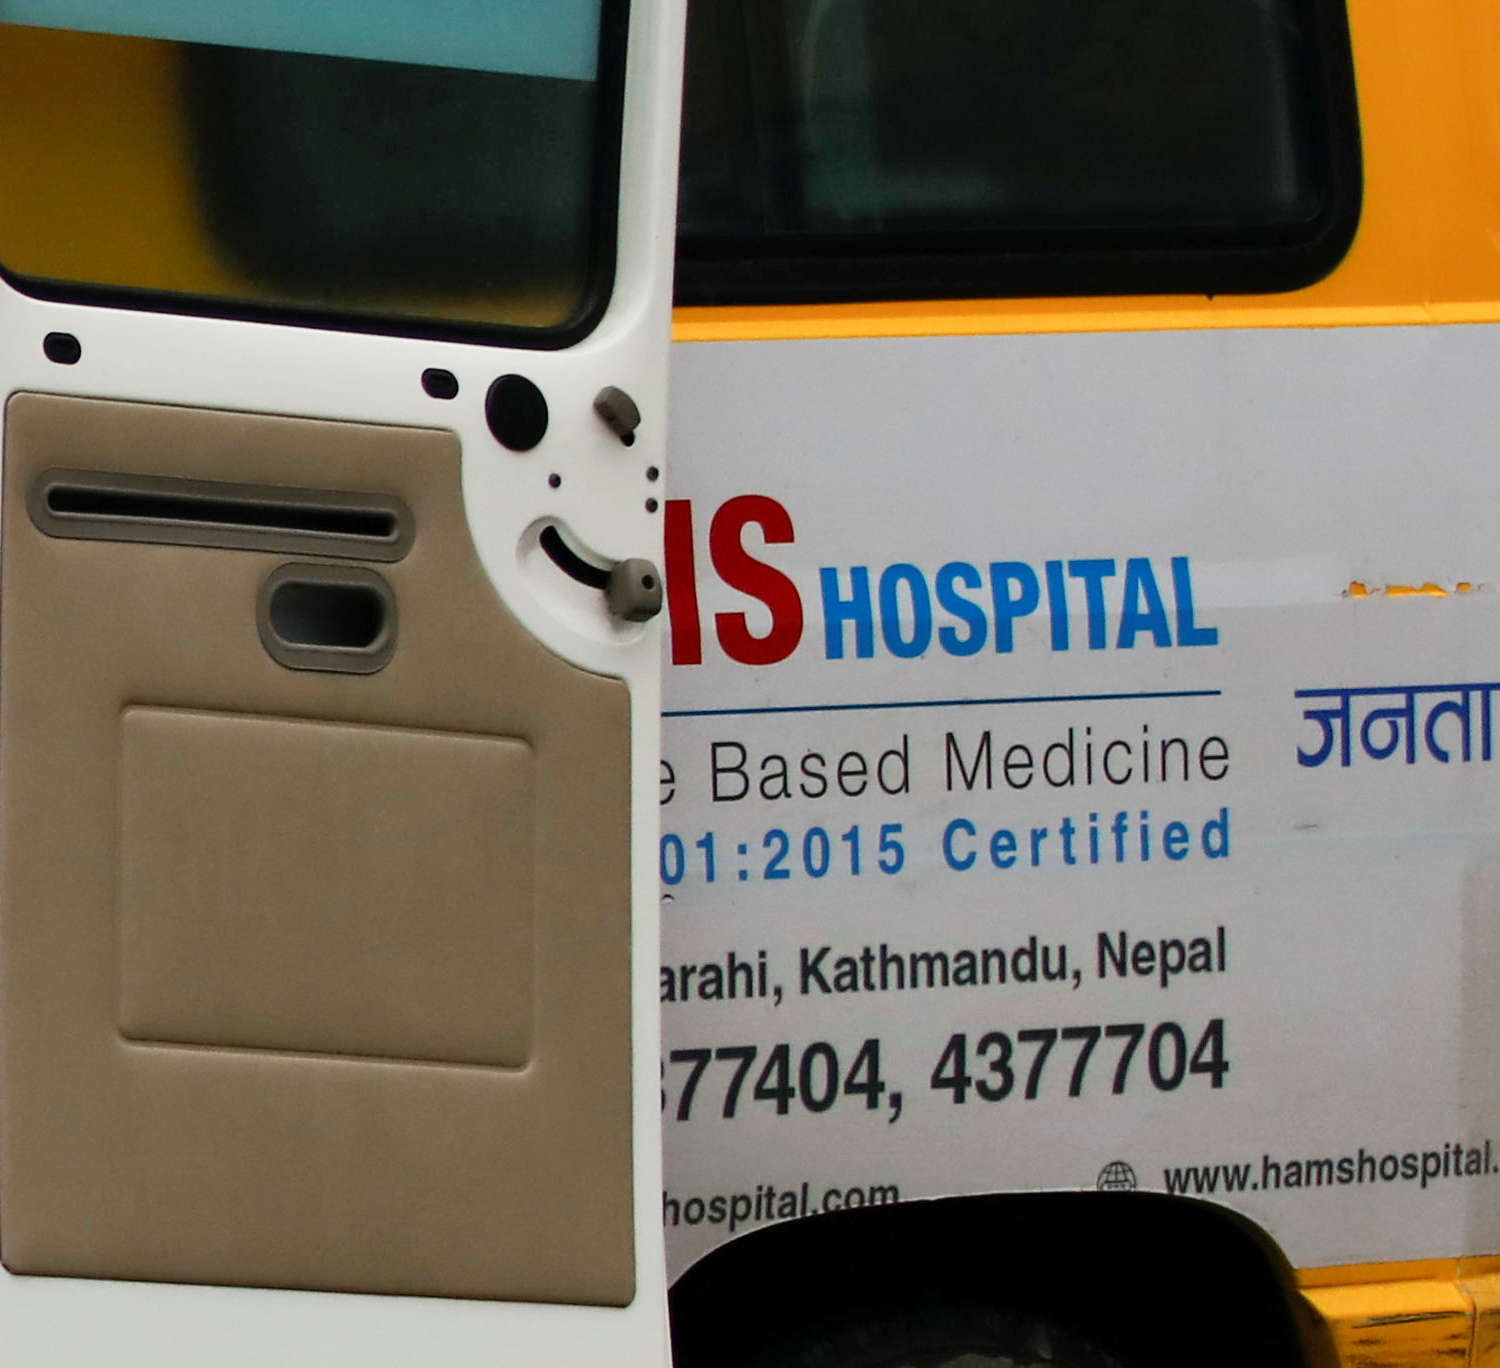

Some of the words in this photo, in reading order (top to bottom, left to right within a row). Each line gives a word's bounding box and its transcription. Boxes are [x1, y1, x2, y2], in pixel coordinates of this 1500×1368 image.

[819, 556, 1220, 660] HOSPITAL
[710, 733, 910, 802] Based
[945, 724, 1229, 792] Medicine
[1294, 682, 1500, 768] जनता
[943, 807, 1231, 872] Certified
[800, 936, 1083, 996] Kathmandu,
[1098, 926, 1226, 987] Nepal
[660, 1037, 903, 1125] 77404,
[930, 1018, 1230, 1106] 4377704
